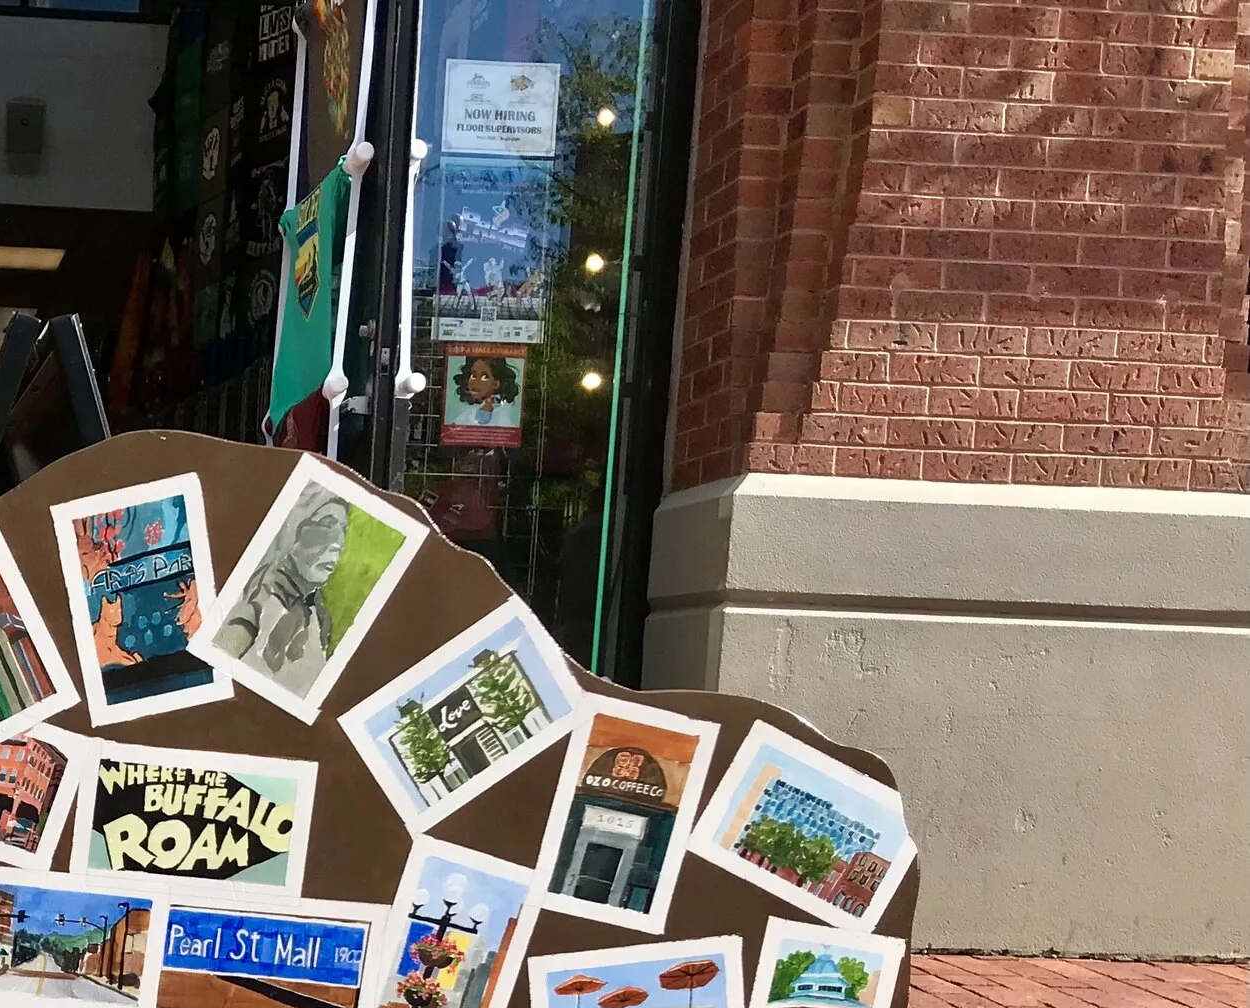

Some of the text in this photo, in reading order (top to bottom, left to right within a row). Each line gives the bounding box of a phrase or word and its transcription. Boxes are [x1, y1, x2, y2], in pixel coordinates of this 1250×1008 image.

[456, 123, 541, 134] FLOOR SUPERVISORS
[465, 109, 536, 121] NOW HIRING
[439, 700, 471, 733] Love
[99, 762, 227, 795] WHERE THE
[586, 775, 611, 788] OZO
[612, 779, 649, 795] COFFEE
[143, 784, 293, 853] BUFFALO
[597, 814, 634, 829] 1015
[103, 813, 249, 871] ROAM
[167, 924, 222, 959] Pearl
[229, 928, 261, 964] St
[273, 933, 321, 969] Mall
